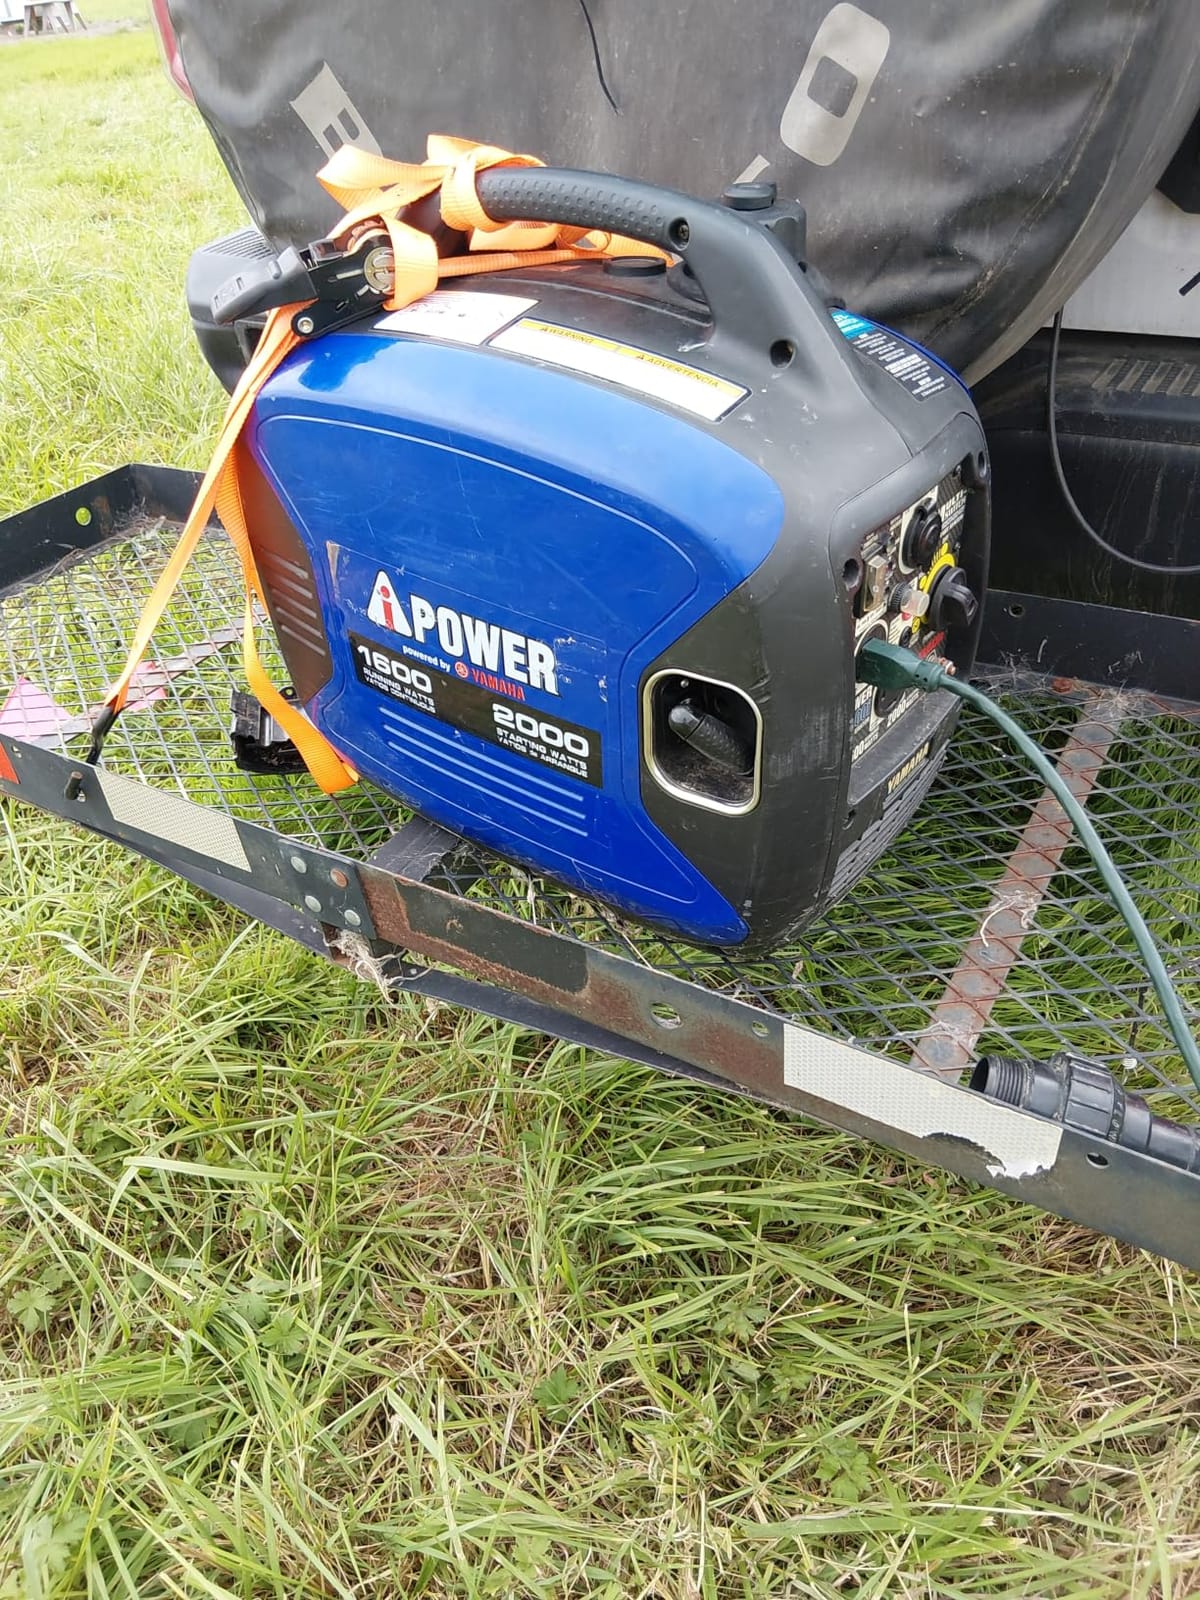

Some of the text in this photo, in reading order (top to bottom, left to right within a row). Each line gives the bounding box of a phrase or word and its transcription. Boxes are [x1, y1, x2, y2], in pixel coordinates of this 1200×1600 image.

[550, 327, 595, 345] WARNING
[648, 354, 719, 388] ADVERTENCIA
[356, 644, 433, 694] 1600
[402, 644, 451, 673] powered by
[363, 666, 435, 707] RUNNING WATTS
[470, 668, 526, 701] YAMAHA
[491, 702, 590, 758] 2000
[496, 726, 588, 771] STARTING WATTS
[540, 753, 589, 779] ARRANQUE
